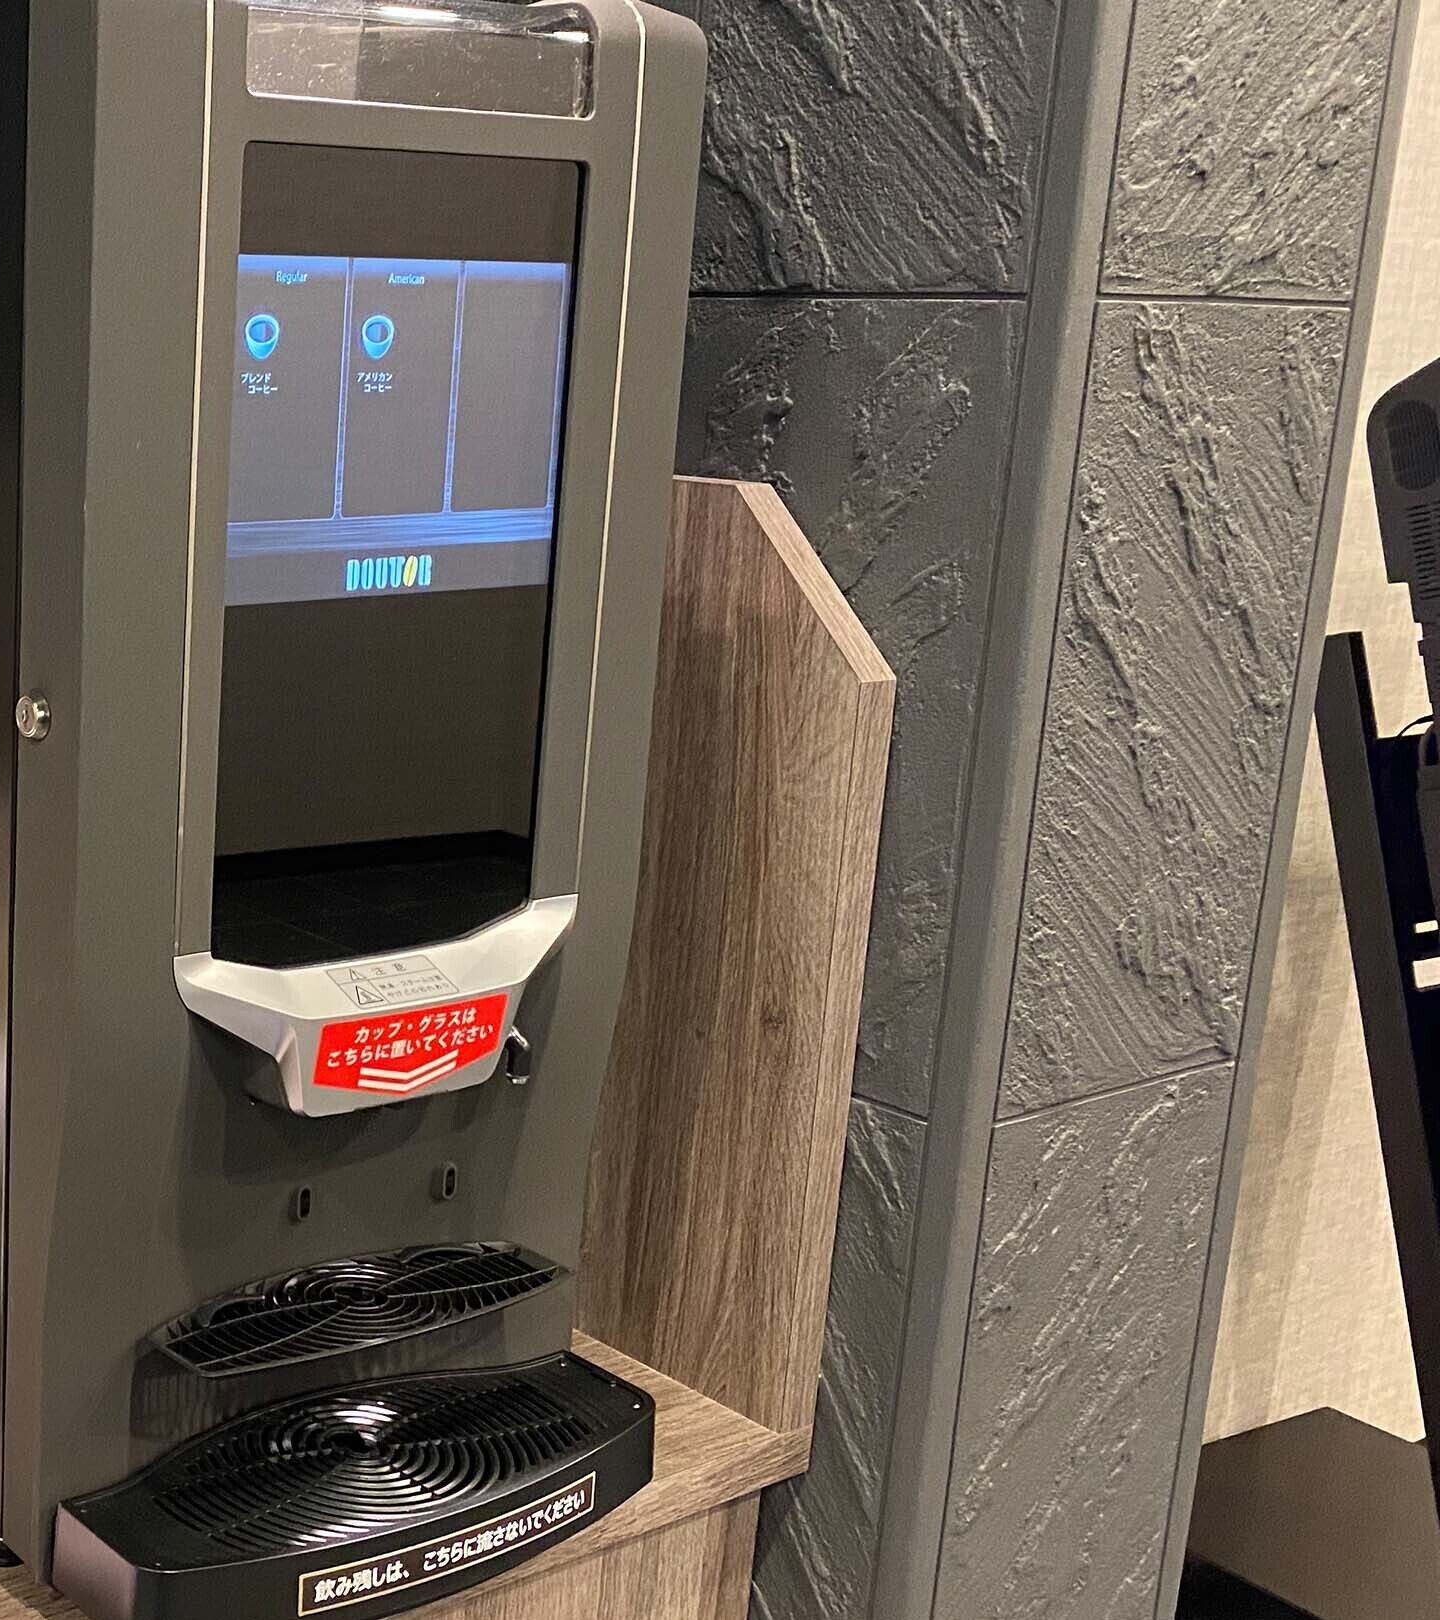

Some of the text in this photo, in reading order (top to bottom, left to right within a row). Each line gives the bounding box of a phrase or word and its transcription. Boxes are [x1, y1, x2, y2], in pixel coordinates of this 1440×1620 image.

[276, 270, 309, 285] Regular
[388, 273, 425, 285] American
[241, 372, 272, 385] ブレンド
[356, 372, 393, 383] アメリカン
[248, 385, 278, 395] コーヒー
[364, 384, 393, 394] コーヒー
[345, 553, 433, 593] DOUTOR
[354, 1006, 478, 1045] カップ・グラスは
[327, 1023, 495, 1068] こちらに置いてください
